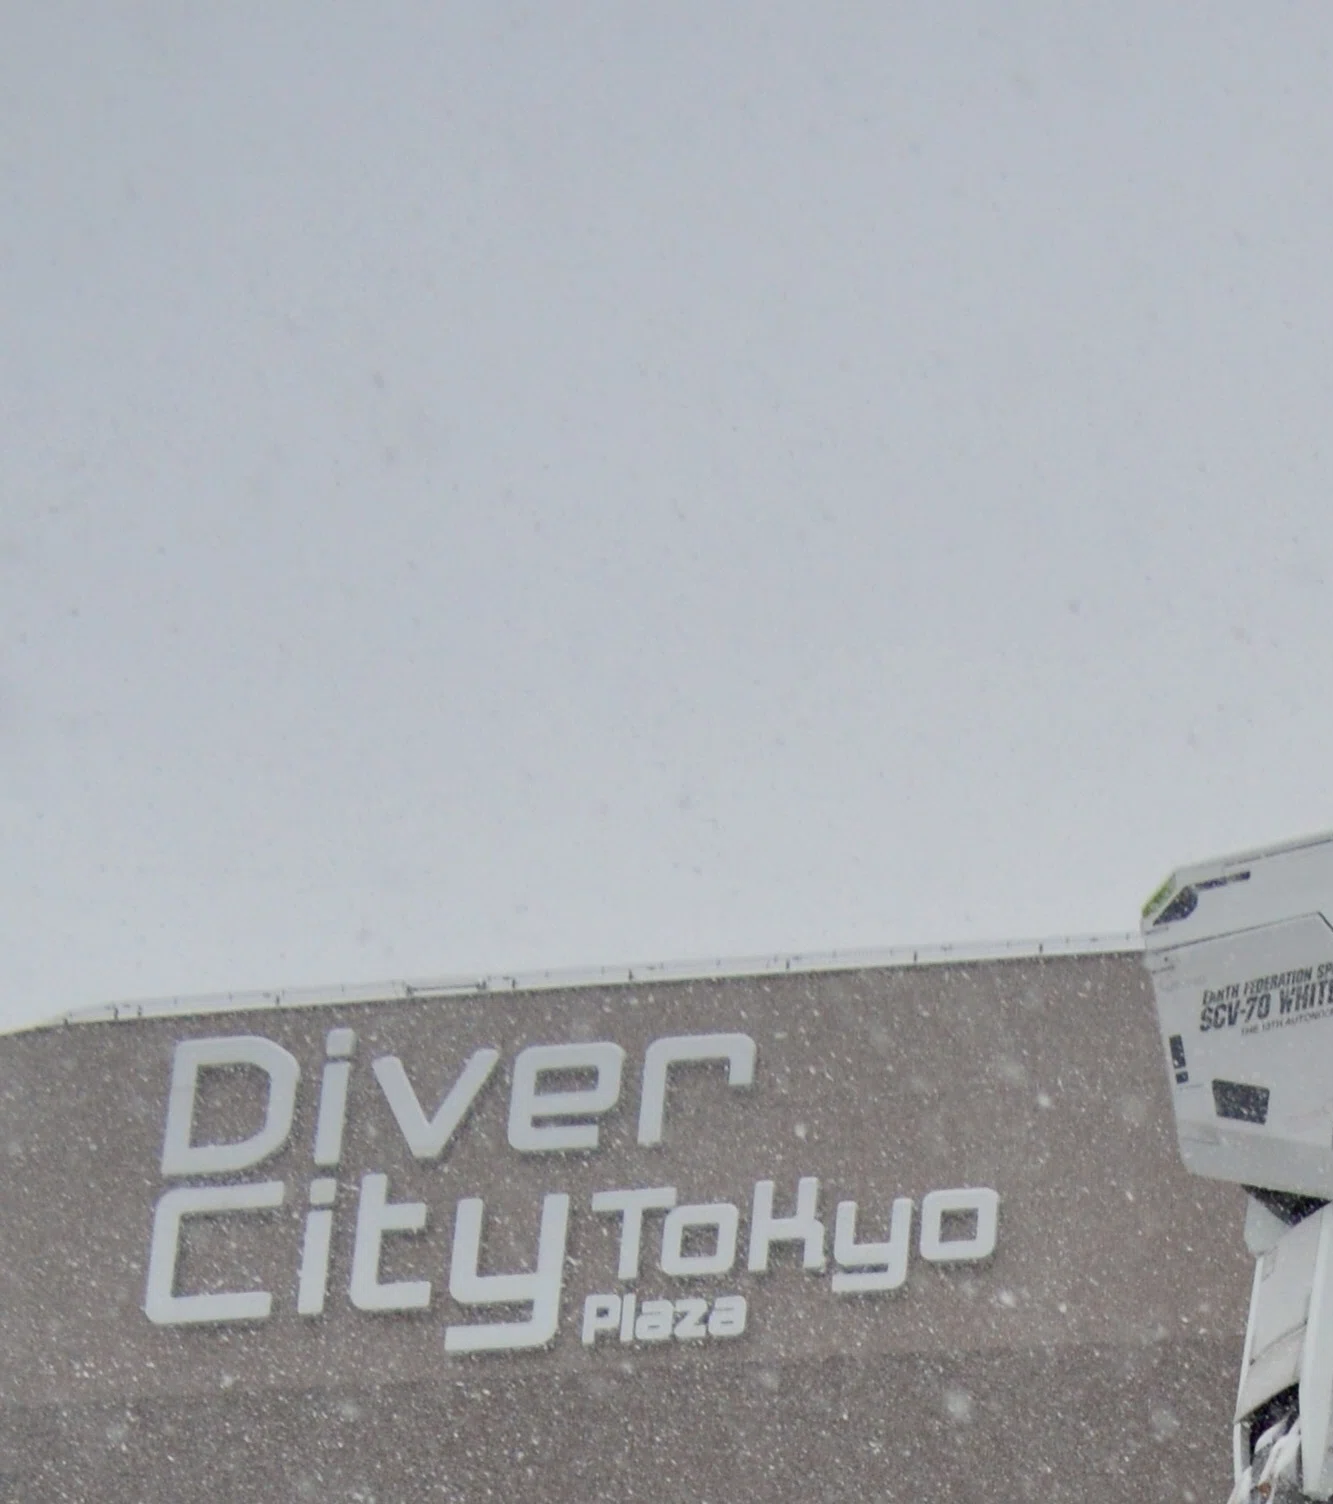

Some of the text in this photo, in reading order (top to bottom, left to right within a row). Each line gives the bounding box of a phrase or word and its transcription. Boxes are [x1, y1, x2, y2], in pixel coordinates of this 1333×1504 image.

[1244, 966, 1313, 997] FEDERATION
[1200, 992, 1272, 1032] SCV-70
[160, 1028, 757, 1178] Diver
[144, 1174, 571, 1352] City
[581, 1294, 748, 1346] Plaza
